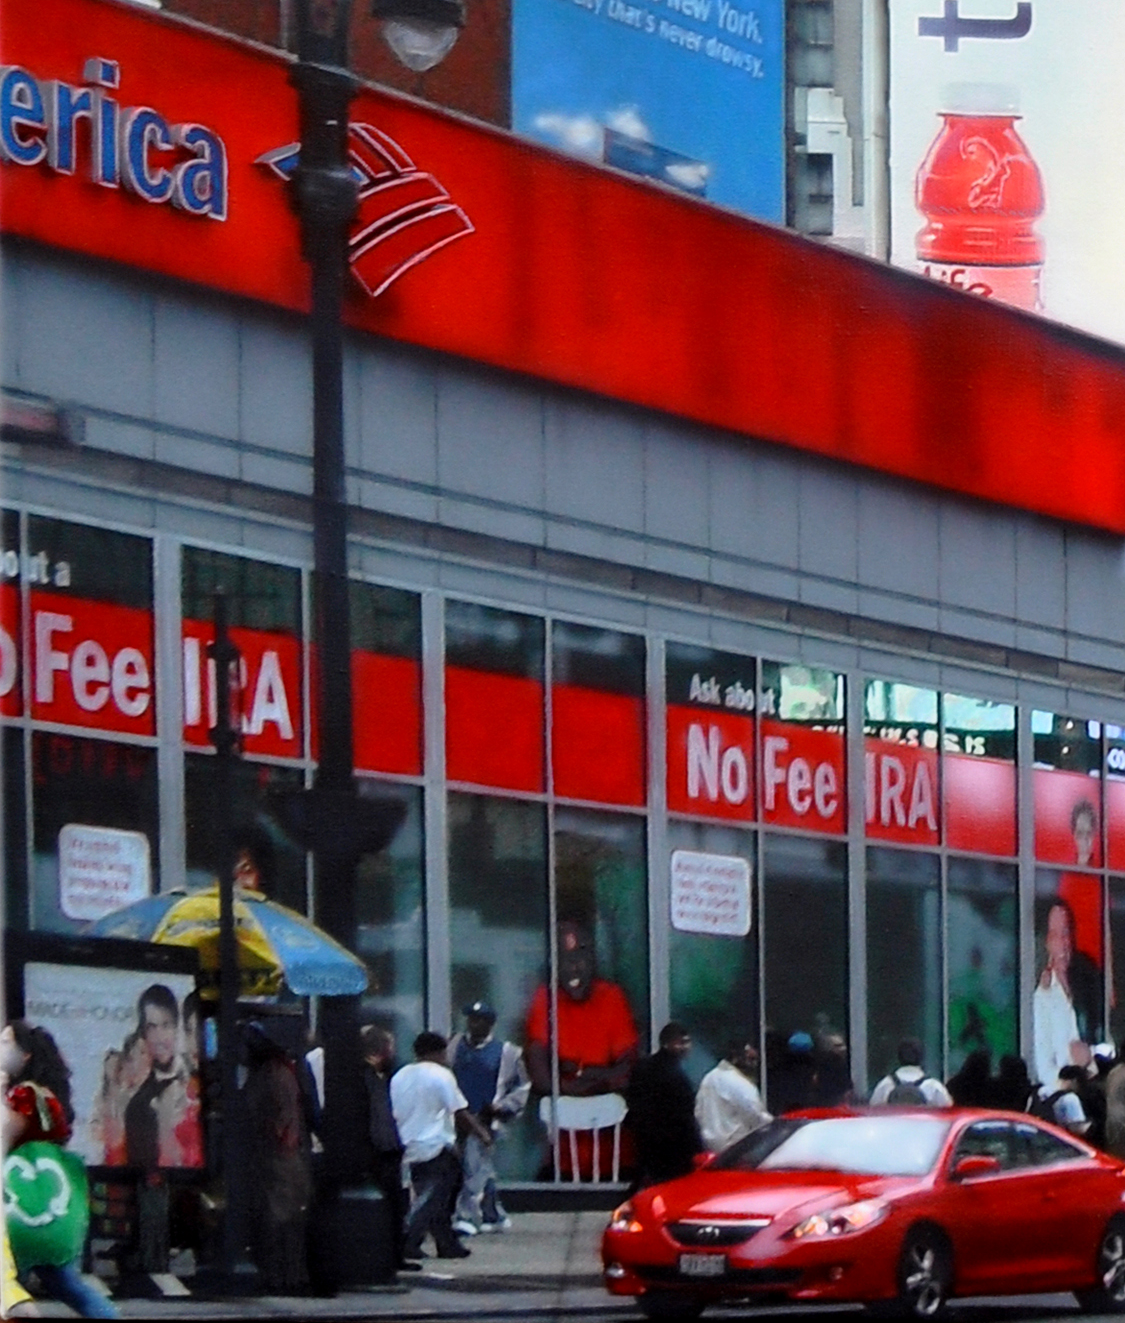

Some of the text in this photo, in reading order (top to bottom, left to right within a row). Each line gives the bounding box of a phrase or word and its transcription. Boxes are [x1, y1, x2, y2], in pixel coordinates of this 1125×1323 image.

[659, 20, 704, 53] never
[54, 560, 71, 587] a
[35, 610, 150, 717] Fee
[689, 672, 721, 706] Ask
[687, 724, 939, 832] No Fee IRA
